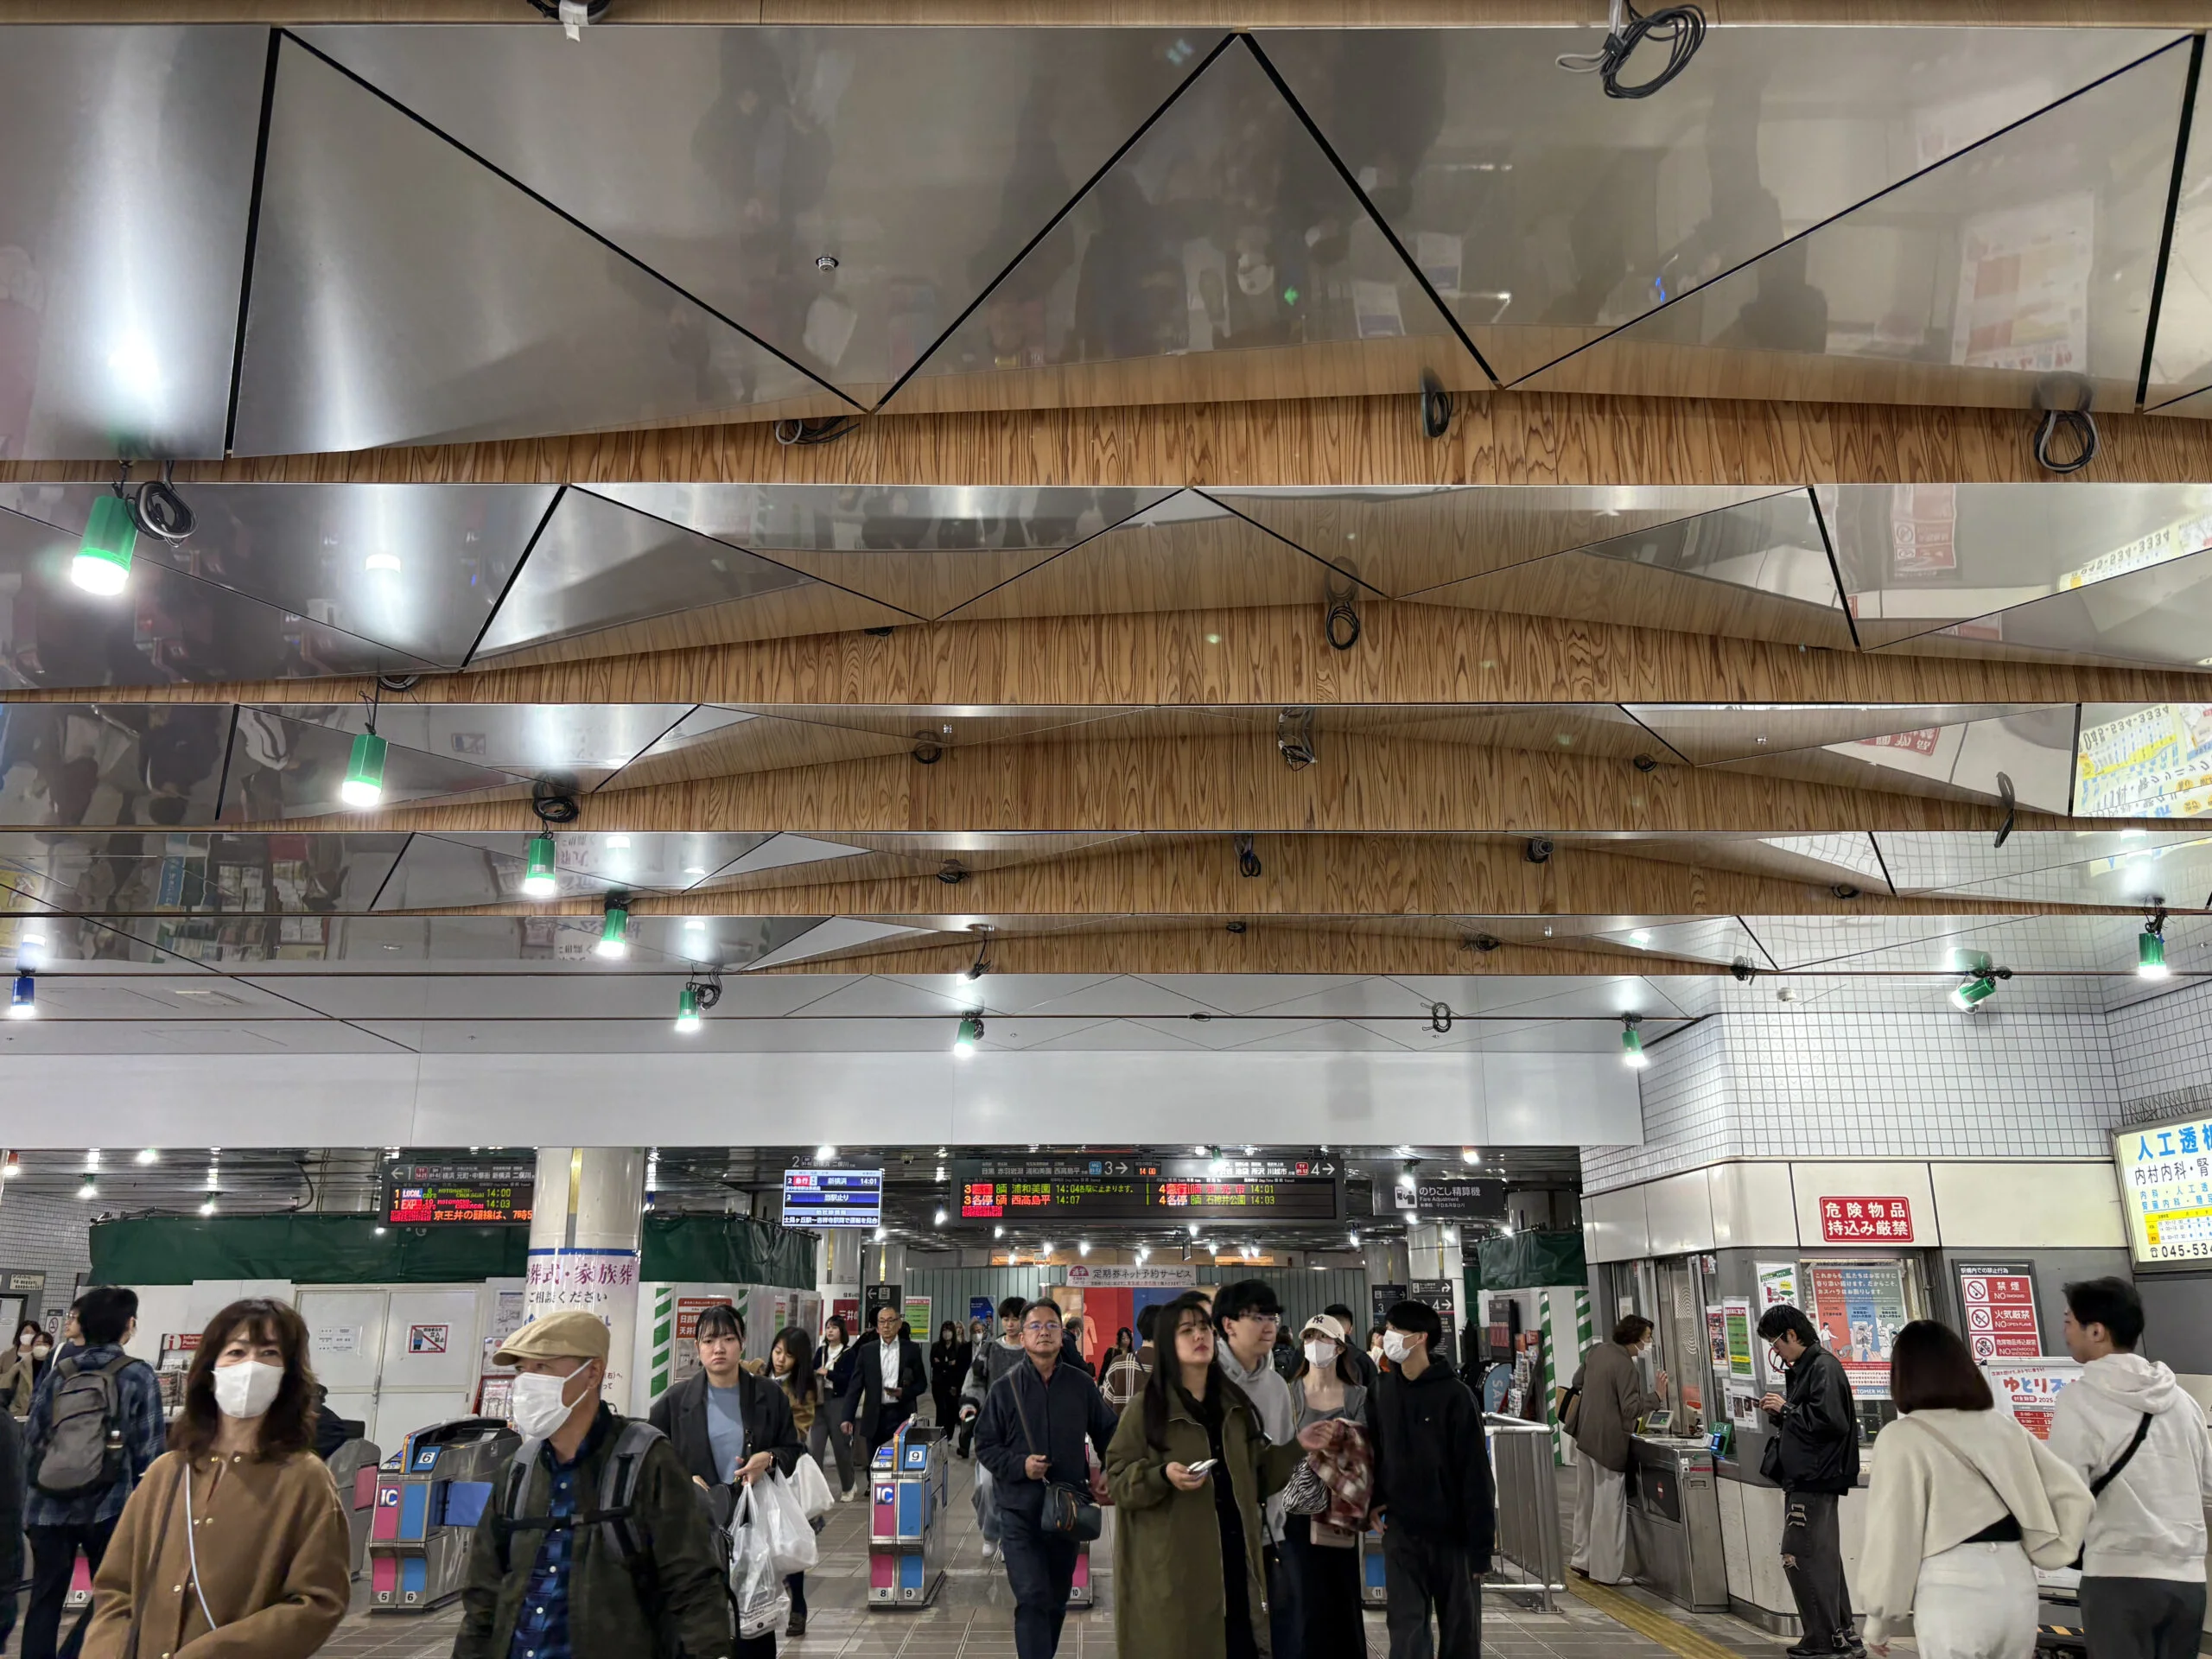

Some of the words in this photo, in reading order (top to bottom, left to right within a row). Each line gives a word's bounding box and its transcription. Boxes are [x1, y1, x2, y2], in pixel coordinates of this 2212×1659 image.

[791, 1156, 799, 1167] 2
[1104, 1161, 1113, 1175] 3
[1311, 1162, 1320, 1176] 4
[394, 1189, 399, 1198] 1
[486, 1188, 512, 1198] 14:00
[964, 1185, 972, 1194] 3
[1012, 1184, 1051, 1194] 浦和美園
[1056, 1185, 1079, 1193] 14:04
[1159, 1185, 1166, 1193] 4
[1251, 1185, 1274, 1194] 14:01
[1419, 1186, 1480, 1196] のりこし精算機
[394, 1200, 399, 1210] 1
[486, 1199, 511, 1209] 14:03
[964, 1195, 972, 1205] 3
[972, 1195, 993, 1205] 各停
[1011, 1195, 1051, 1205] 西高島平
[1056, 1195, 1080, 1205] 14:07
[1159, 1196, 1166, 1205] 4
[1251, 1196, 1274, 1205] 14:03
[1825, 1202, 1906, 1218] 危険物品
[434, 1211, 507, 1221] 京王井の頭線は、
[1827, 1220, 1909, 1236] 持込み厳禁
[1093, 1268, 1192, 1280] 定期券ネット予約サービス
[1997, 1281, 2019, 1291] 禁煙
[529, 1291, 607, 1304] ご相談ください
[1378, 1303, 1384, 1313] 3
[1432, 1299, 1440, 1310] 4
[1994, 1310, 2031, 1319] 火気厳禁
[423, 1453, 431, 1462] 6
[912, 1452, 919, 1461] 9
[380, 1489, 398, 1506] IC
[876, 1486, 893, 1504] IC
[407, 1592, 413, 1601] 6
[906, 1589, 912, 1598] 9
